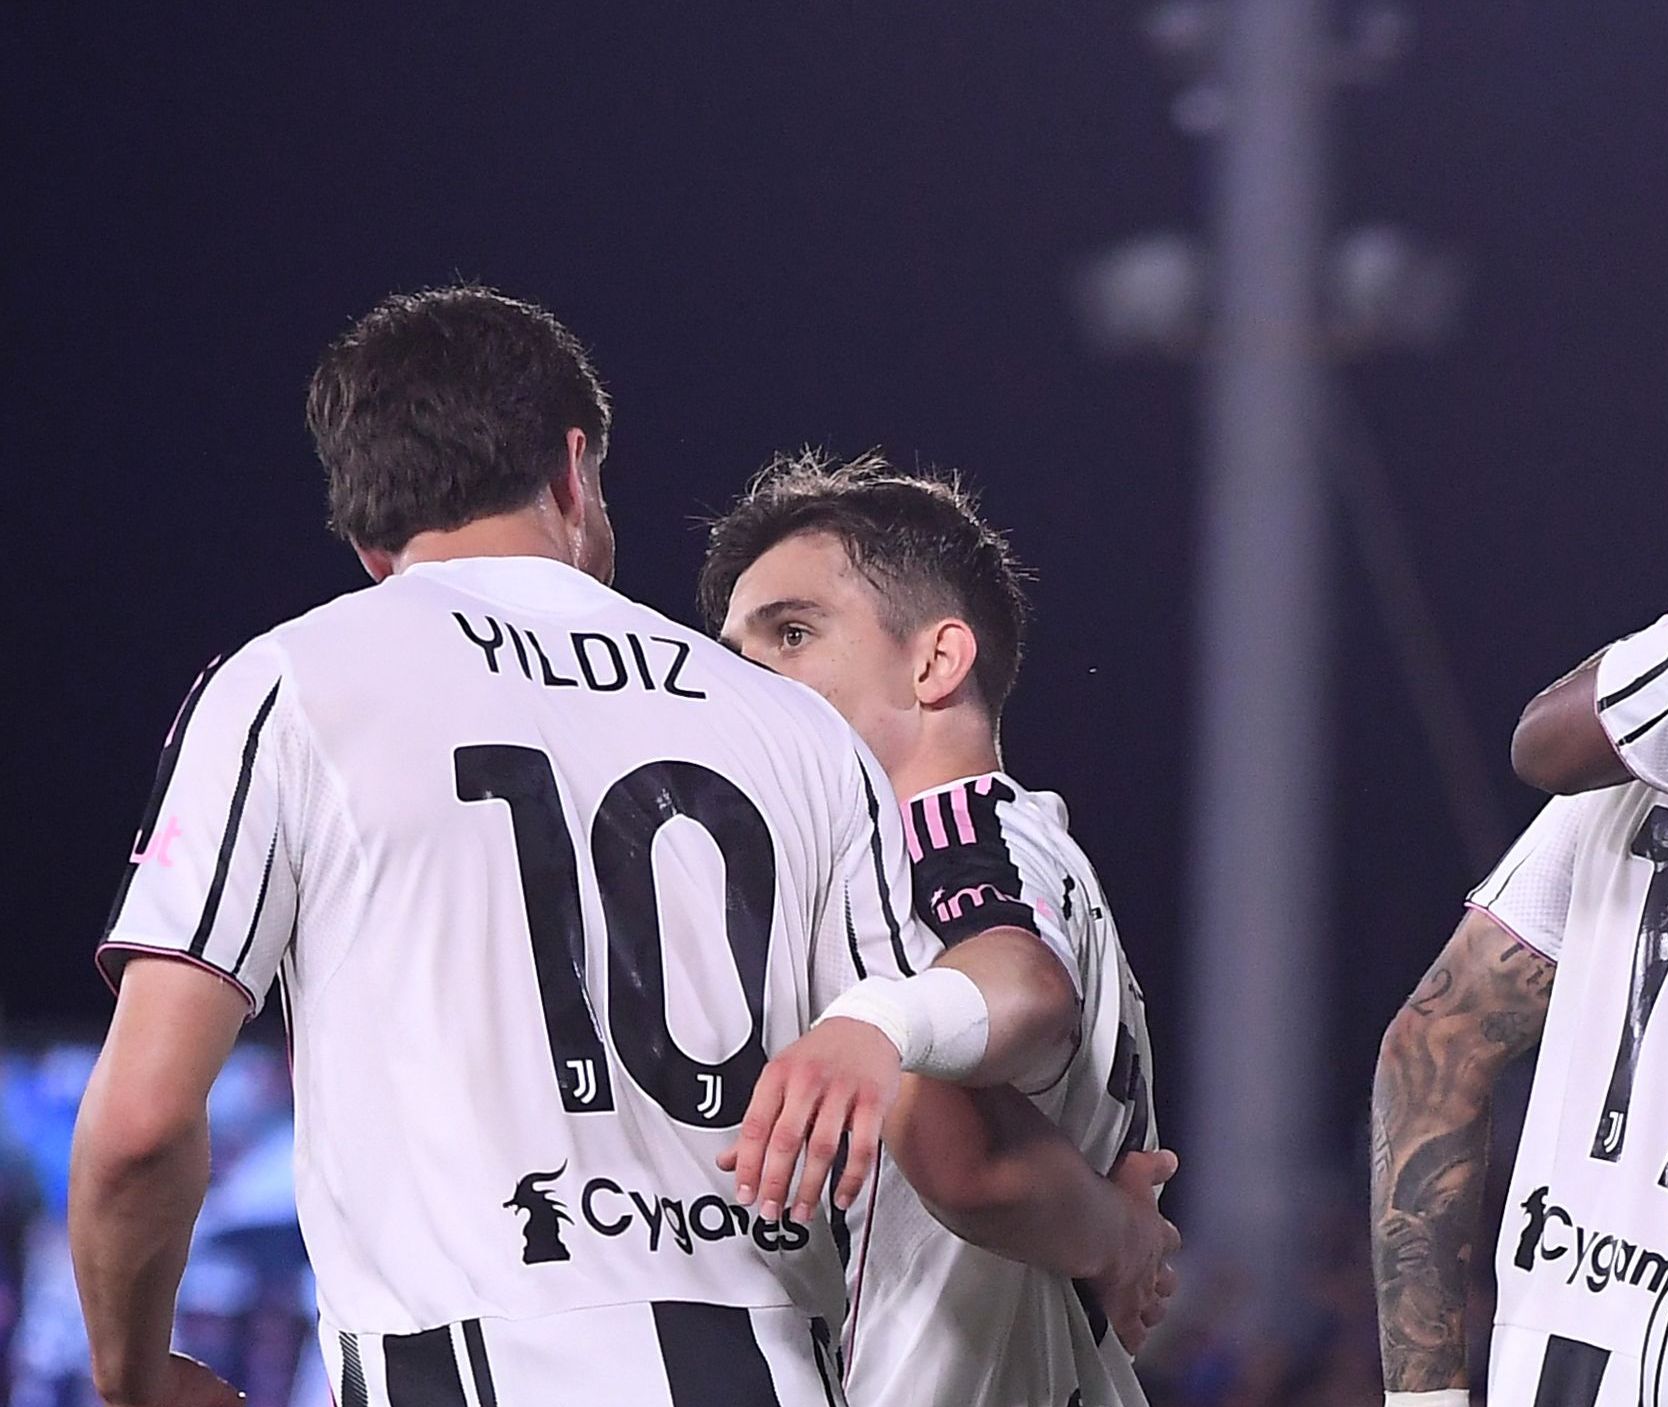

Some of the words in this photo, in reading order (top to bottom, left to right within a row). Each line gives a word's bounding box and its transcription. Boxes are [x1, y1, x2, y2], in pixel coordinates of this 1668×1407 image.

[451, 611, 706, 700] YILDIZ
[454, 743, 776, 1130] 10
[581, 1177, 810, 1256] Cygaes
